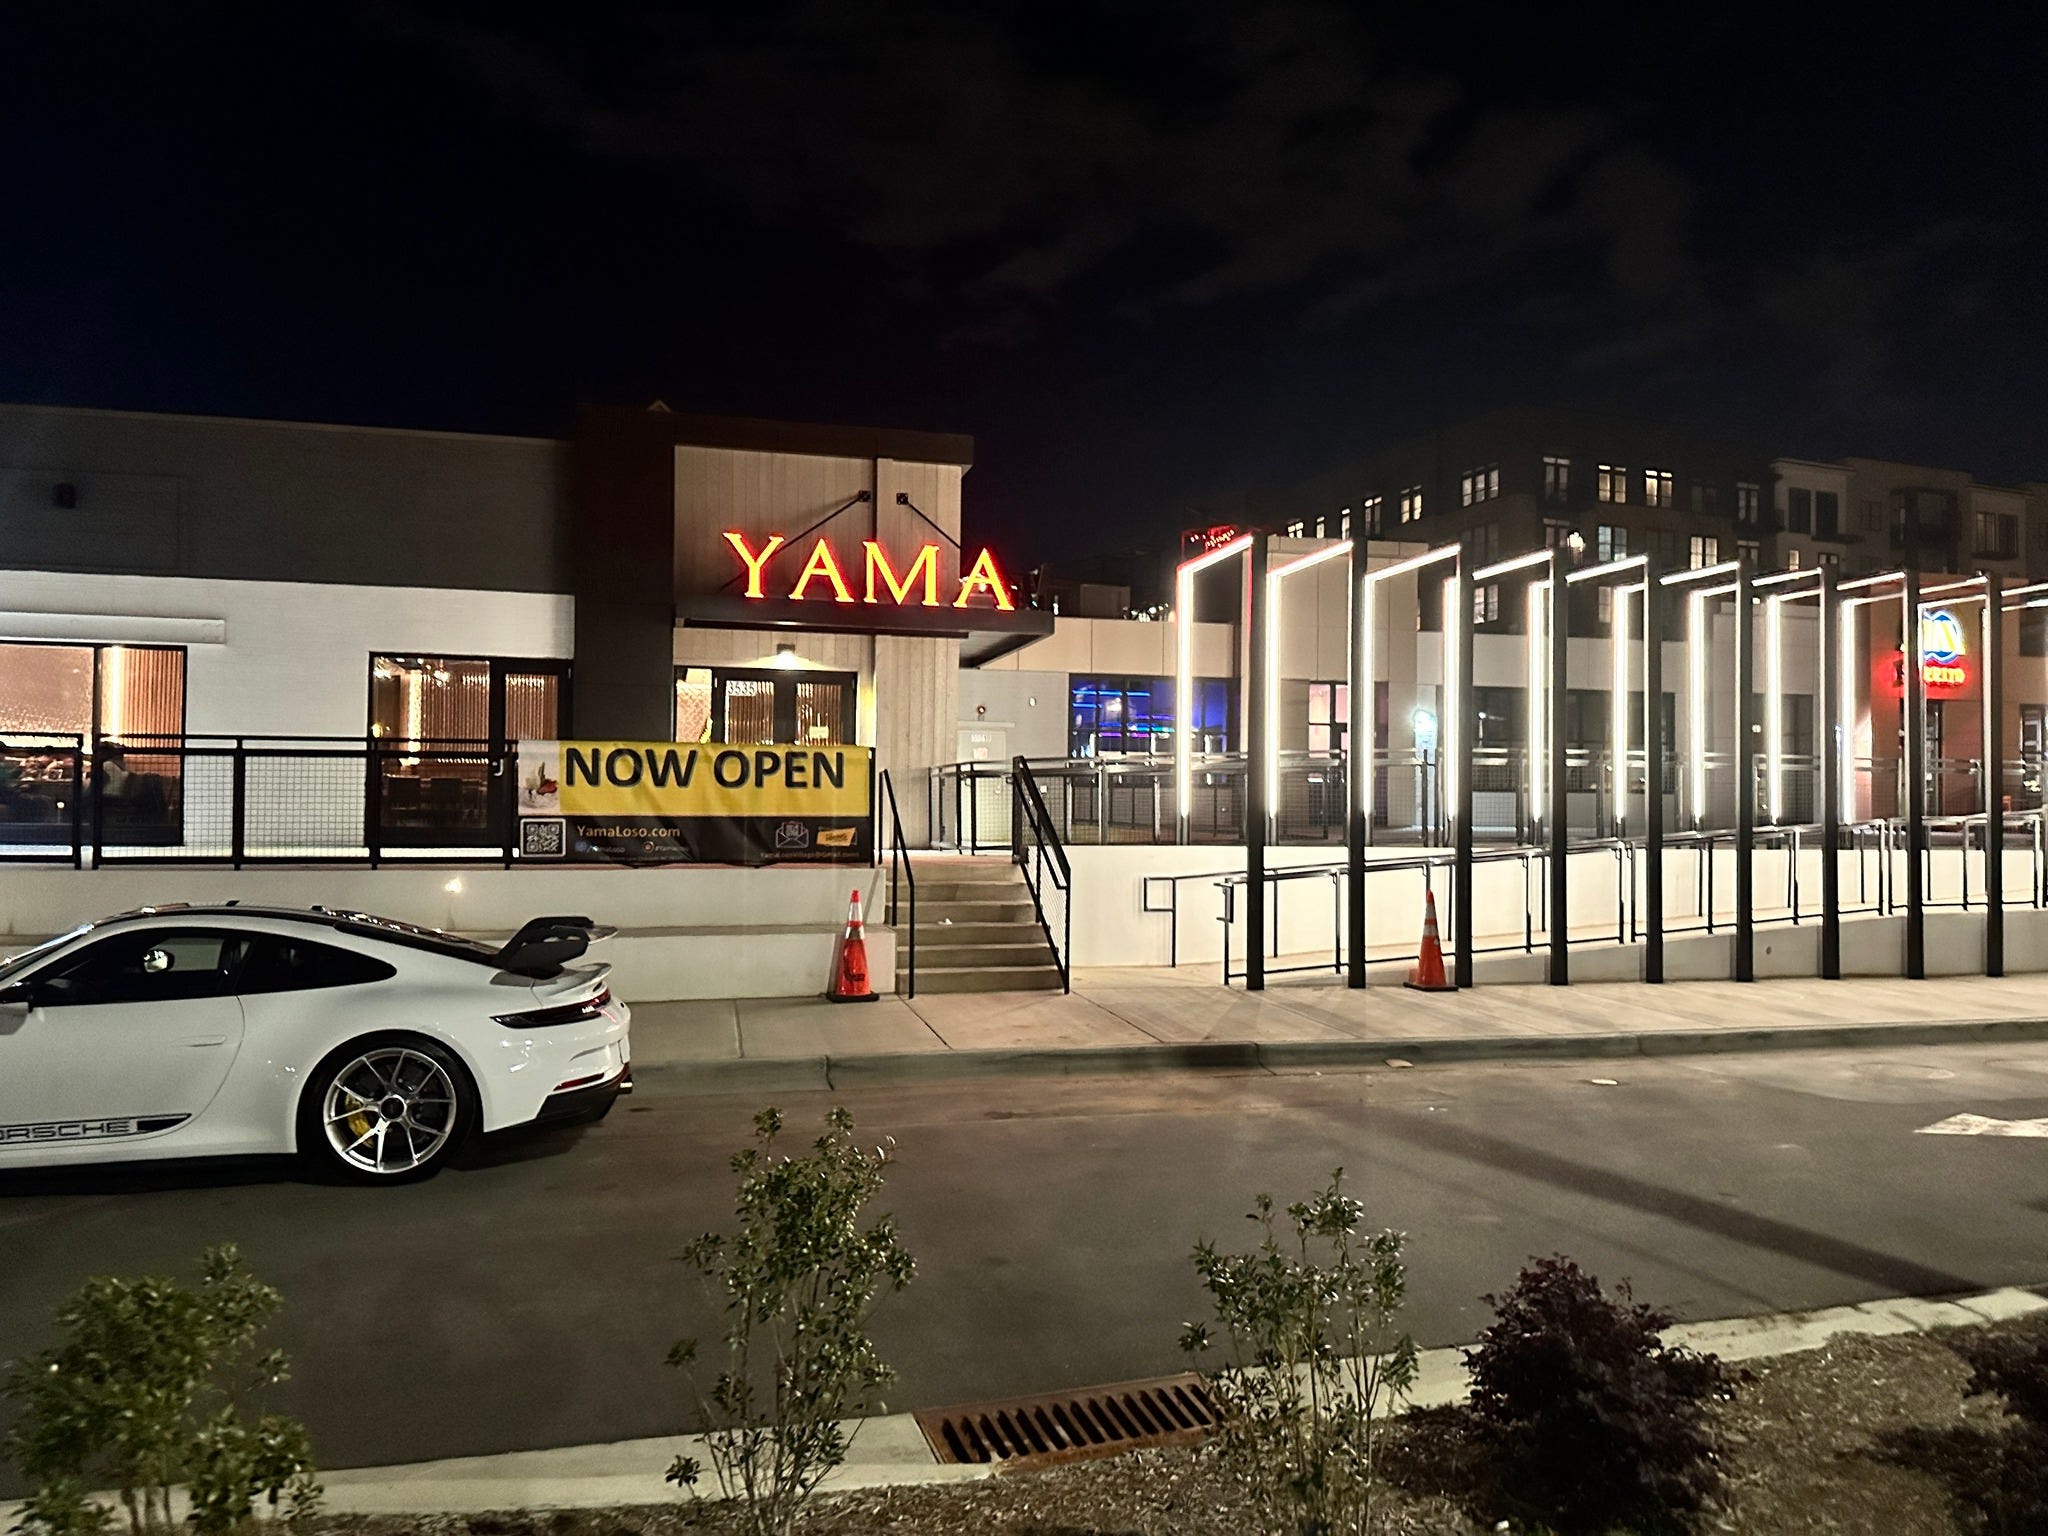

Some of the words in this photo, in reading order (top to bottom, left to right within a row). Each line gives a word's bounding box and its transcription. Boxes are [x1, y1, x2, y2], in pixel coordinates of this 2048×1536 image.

[722, 532, 1016, 611] YAMA
[565, 748, 698, 788] NOW
[713, 749, 844, 789] OPEN
[577, 825, 681, 838] YamaLoso.com
[0, 1120, 131, 1141] RSCHE
